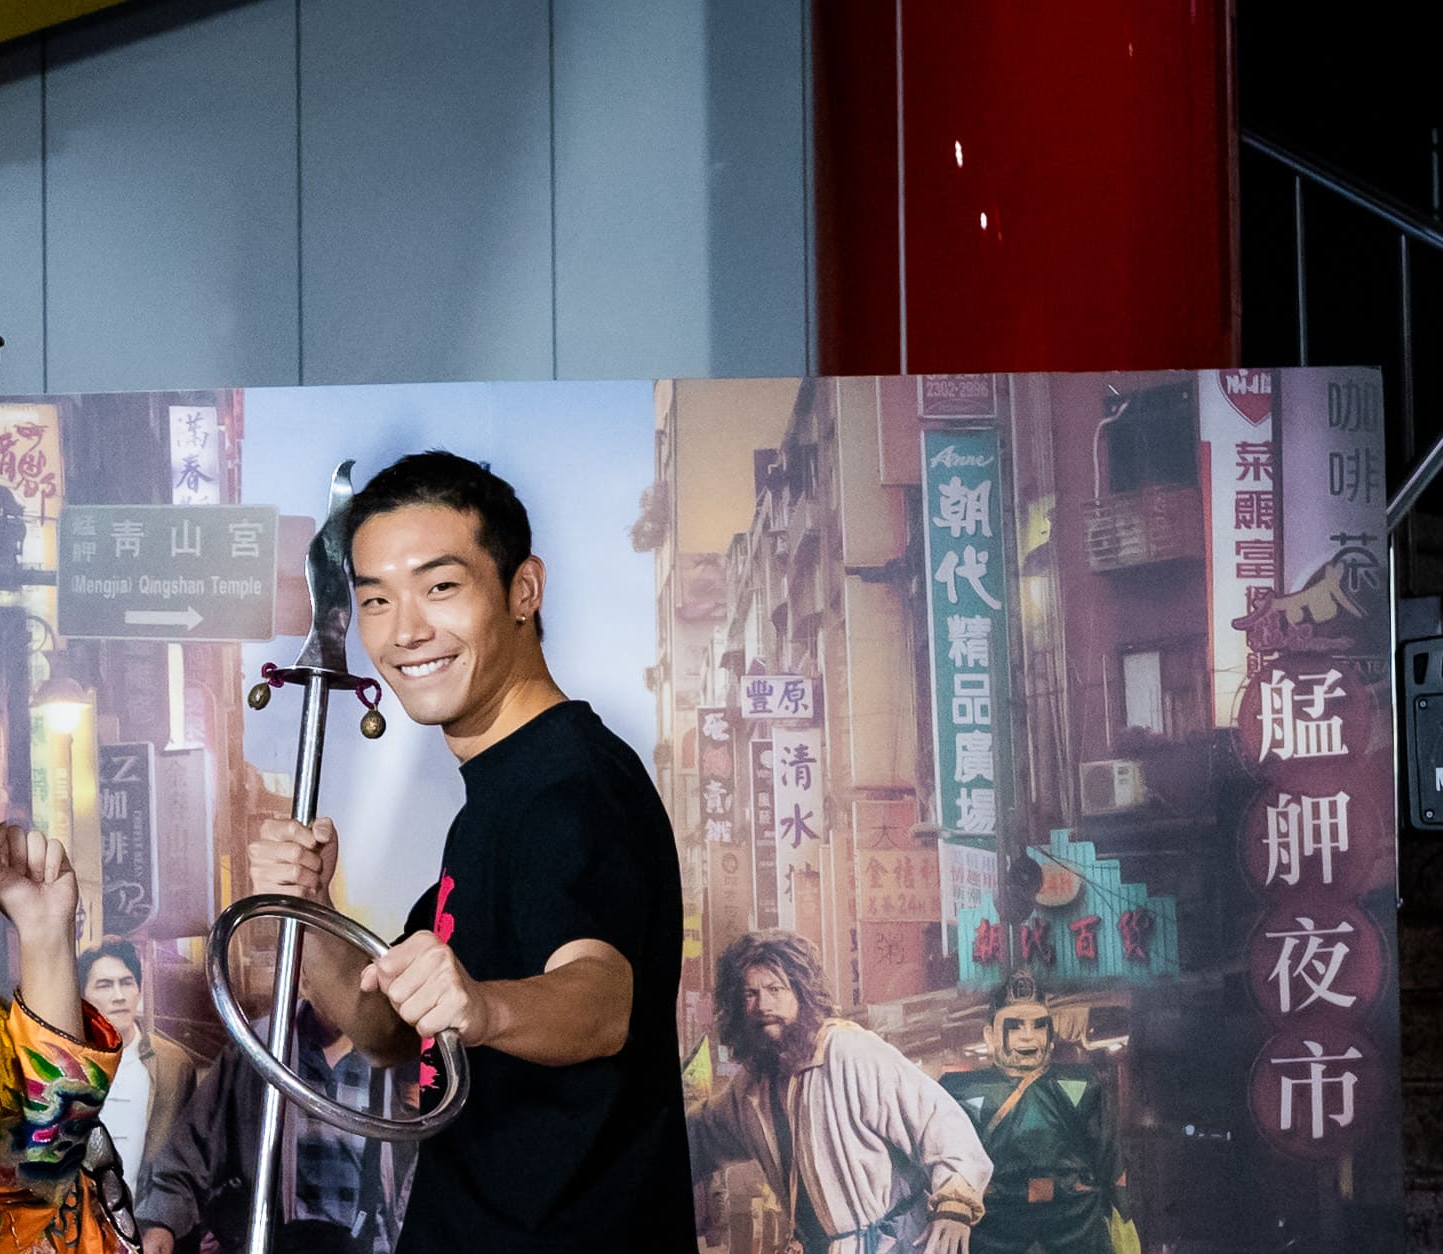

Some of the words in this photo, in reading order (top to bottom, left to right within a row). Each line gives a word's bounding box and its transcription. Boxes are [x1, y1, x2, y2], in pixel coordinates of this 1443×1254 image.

[71, 575, 133, 600] (Mengjia)
[139, 576, 205, 600] Qingshan
[211, 575, 262, 597] Temple
[111, 518, 263, 559] 青山宮
[746, 679, 809, 715] 豐原
[932, 476, 1002, 834] 朝代精品廣場
[780, 744, 820, 903] 清水
[1257, 668, 1363, 1140] 艋舺夜市
